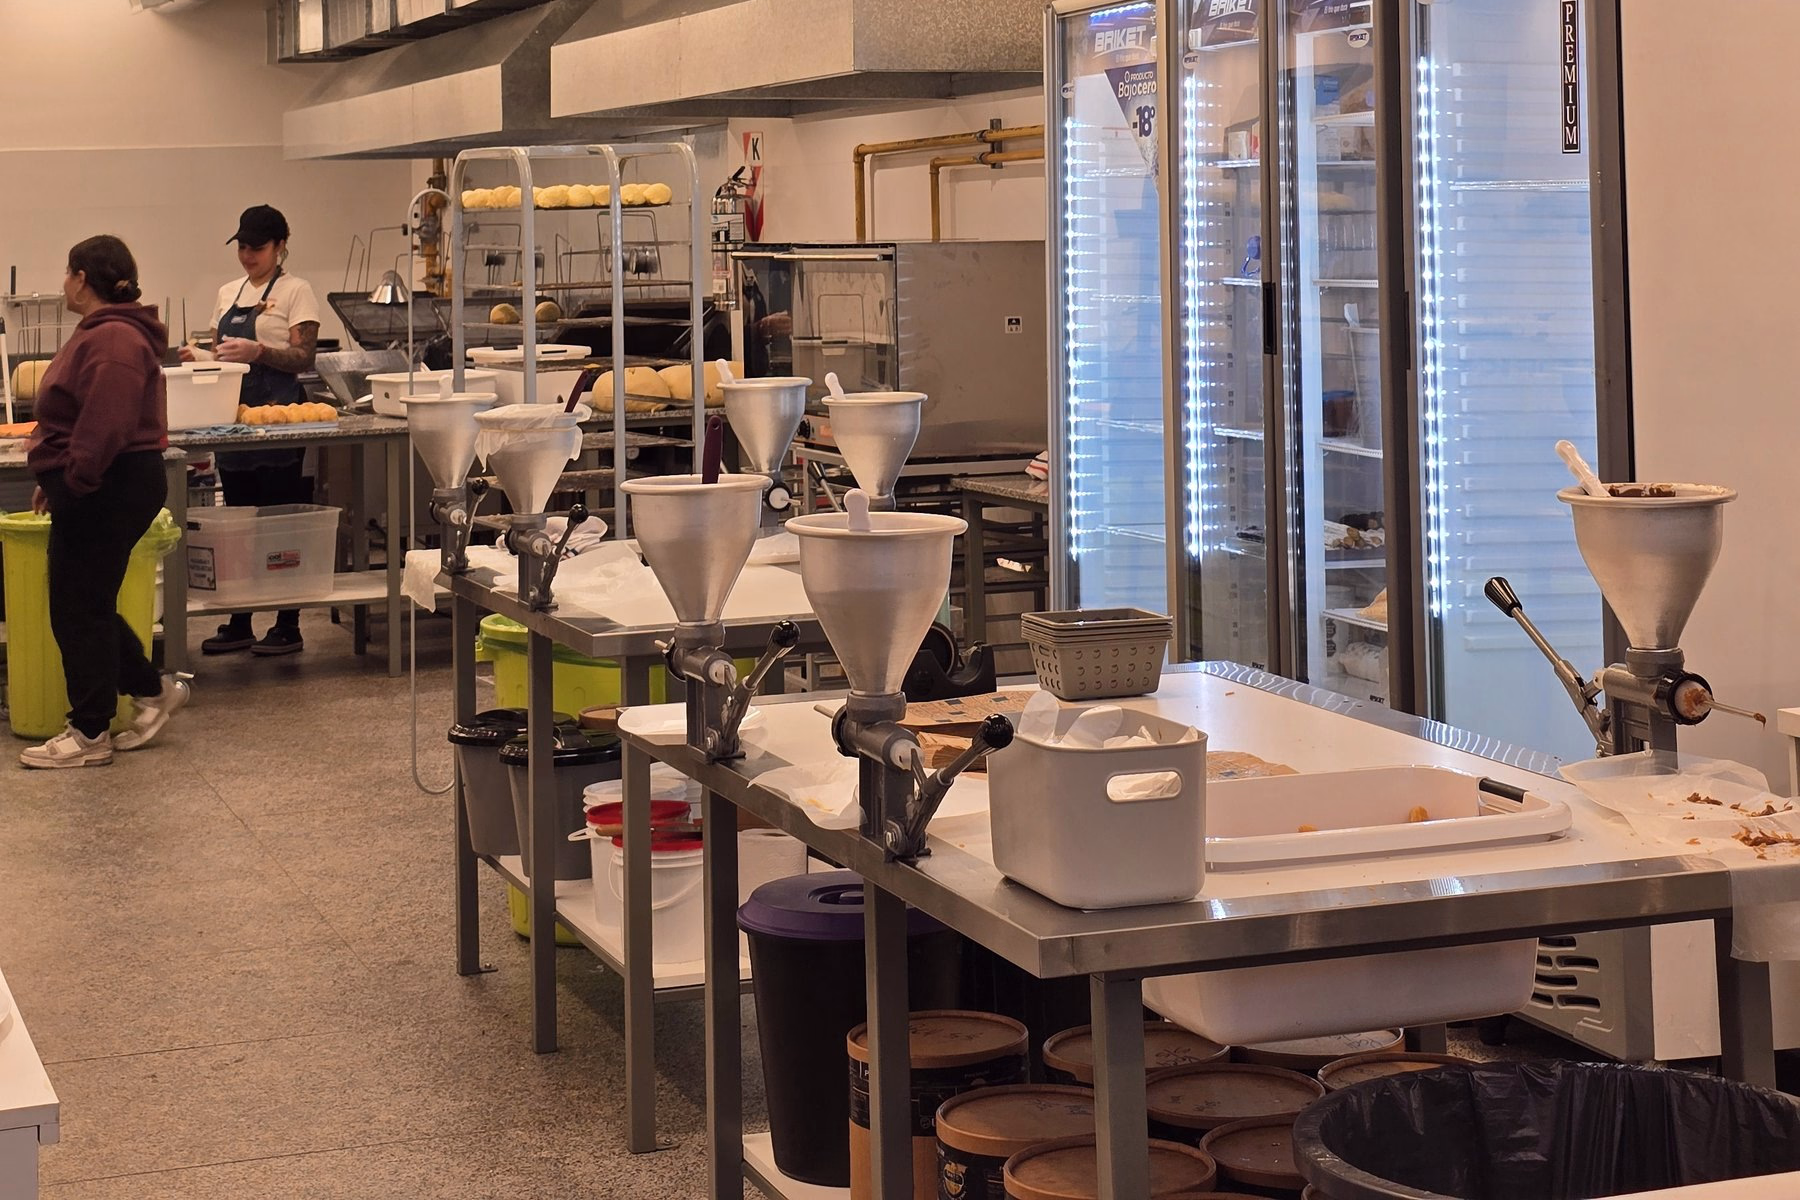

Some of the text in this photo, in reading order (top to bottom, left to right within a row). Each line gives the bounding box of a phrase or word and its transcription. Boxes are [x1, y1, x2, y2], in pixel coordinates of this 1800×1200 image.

[1094, 24, 1147, 53] BRIKET
[1563, 3, 1578, 146] PREMIUM
[751, 136, 761, 161] K
